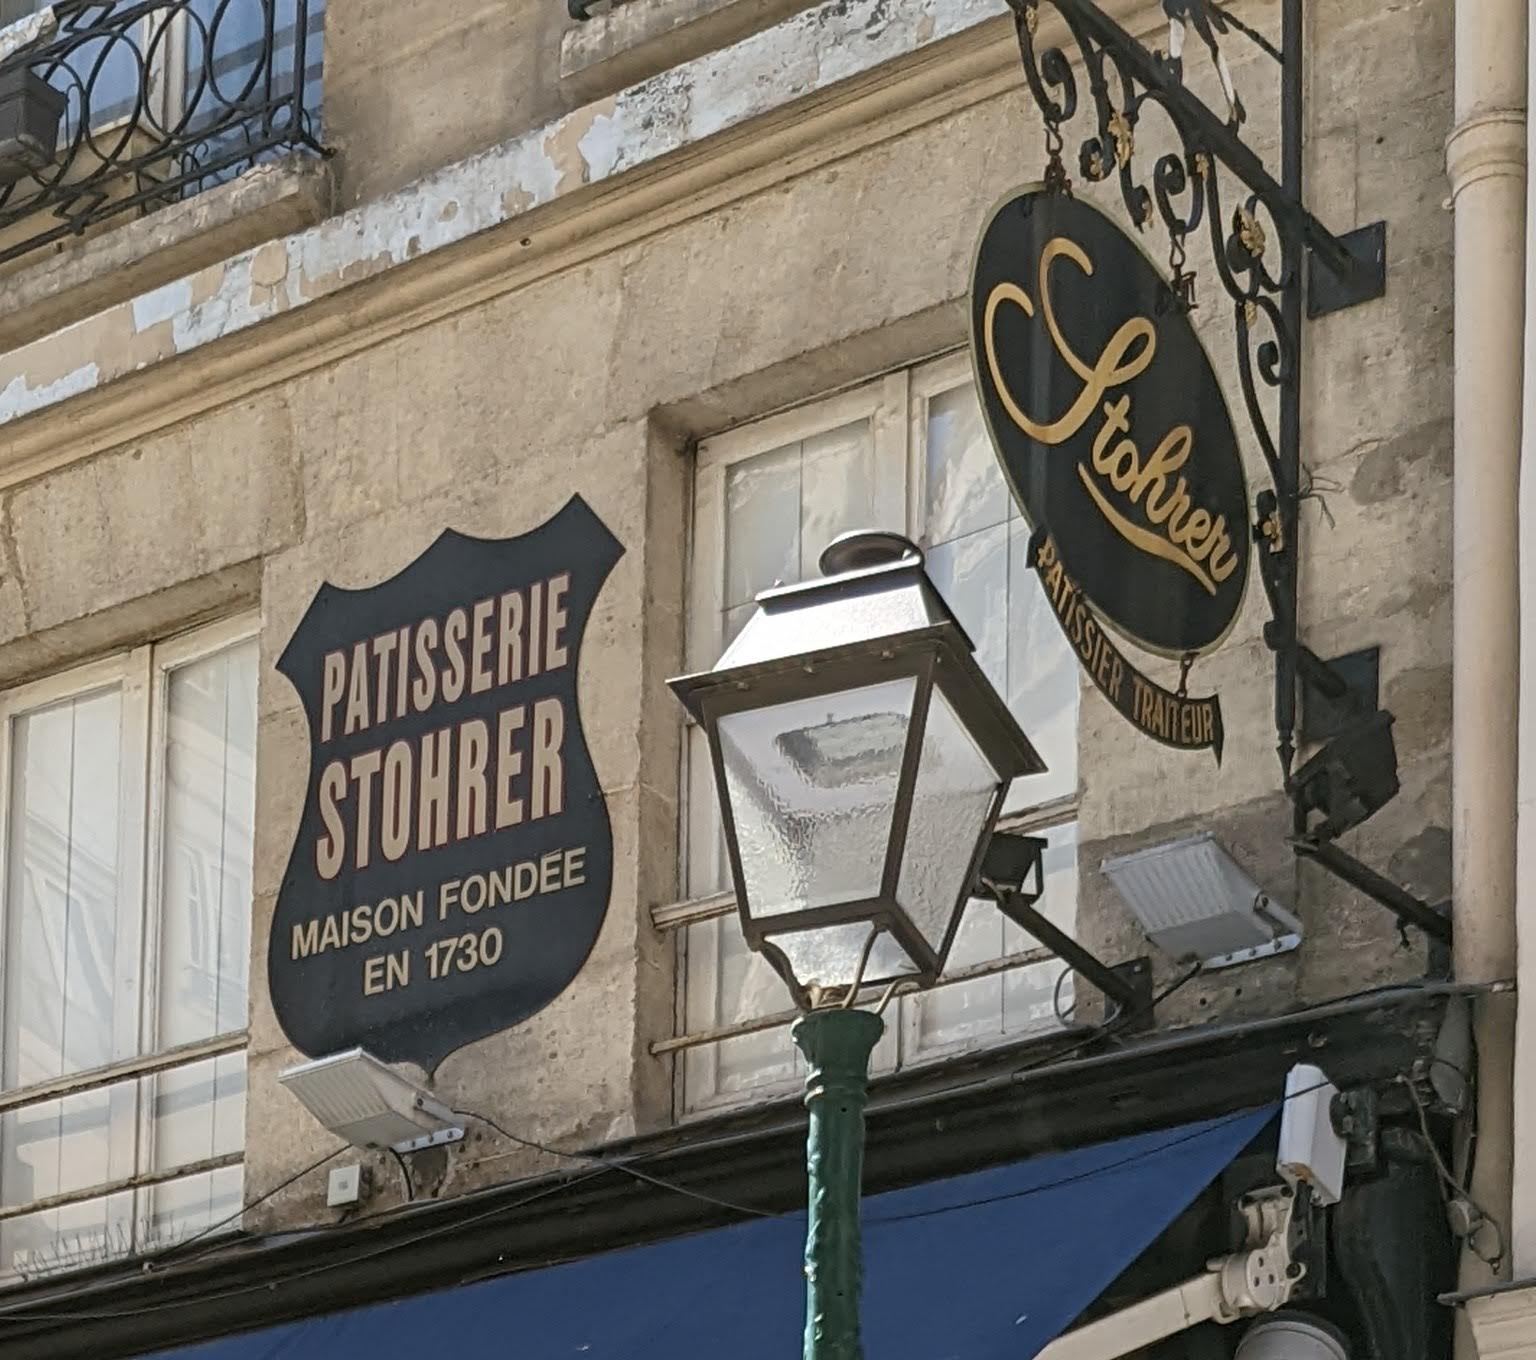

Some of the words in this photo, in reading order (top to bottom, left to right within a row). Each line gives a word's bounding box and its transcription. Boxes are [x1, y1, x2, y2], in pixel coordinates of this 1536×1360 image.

[984, 236, 1239, 583] Stohrer
[321, 571, 571, 744] PATISSERIE
[1037, 535, 1123, 702] PATISSIER
[1132, 674, 1214, 745] TRAITEUR
[315, 697, 565, 881] STOHRER
[291, 890, 424, 961] MAISON
[439, 846, 587, 921] FONDÉE
[363, 949, 410, 996] EN
[424, 926, 503, 980] 1730
